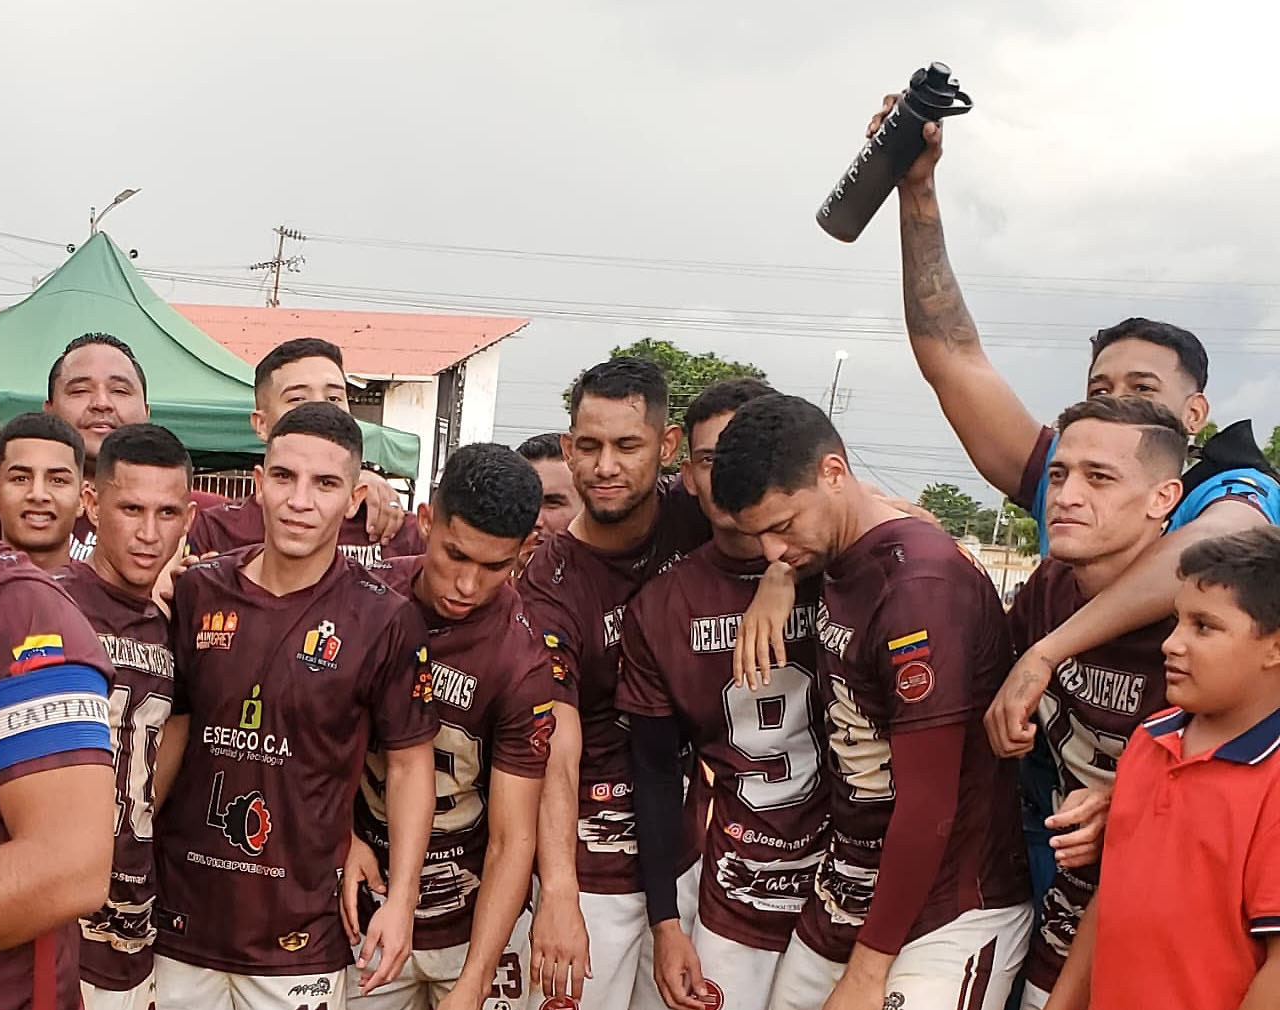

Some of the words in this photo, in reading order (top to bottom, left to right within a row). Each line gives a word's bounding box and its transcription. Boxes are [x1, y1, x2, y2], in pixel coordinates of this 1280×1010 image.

[1076, 663, 1148, 717] NUEVAS
[203, 725, 259, 751] ESERCO
[263, 734, 293, 757] C.A.
[721, 661, 822, 813] 9
